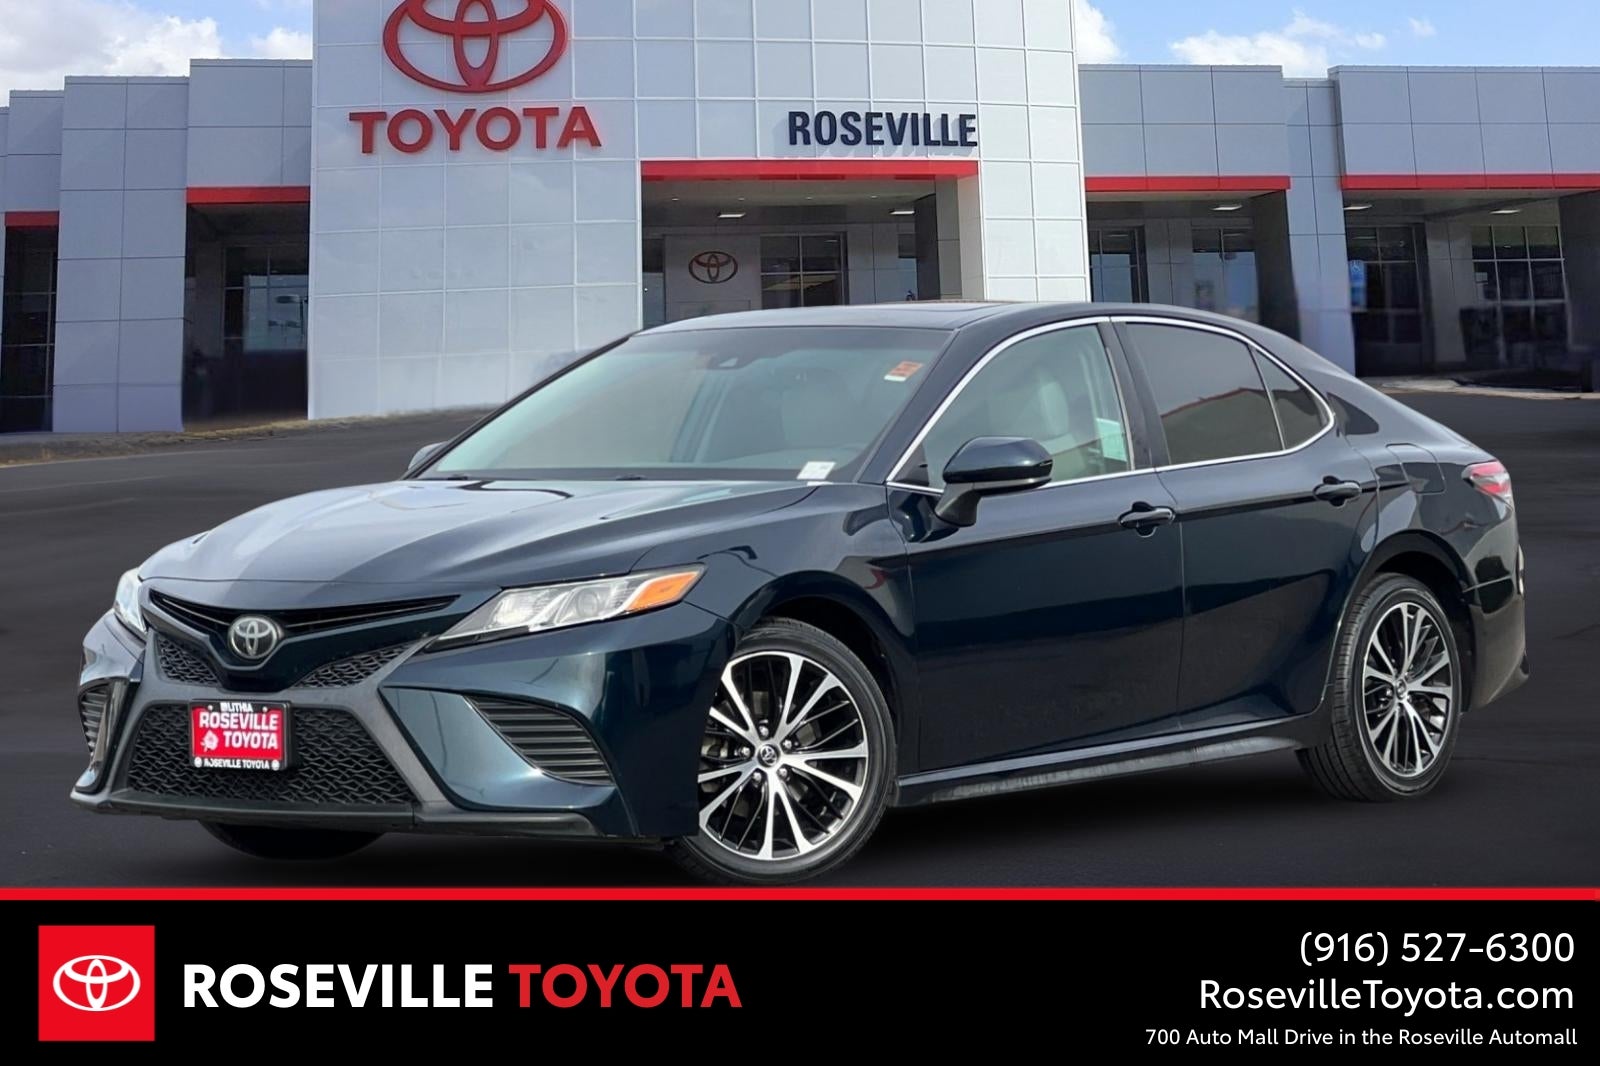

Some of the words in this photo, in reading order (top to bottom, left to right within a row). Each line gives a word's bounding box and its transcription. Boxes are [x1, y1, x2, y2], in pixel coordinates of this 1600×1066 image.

[349, 106, 602, 154] TOYOTA
[788, 111, 978, 147] ROSEVILLE
[199, 712, 279, 730] ROSEVILLE
[223, 731, 278, 749] TOYOTA
[242, 760, 269, 769] TOYOTA
